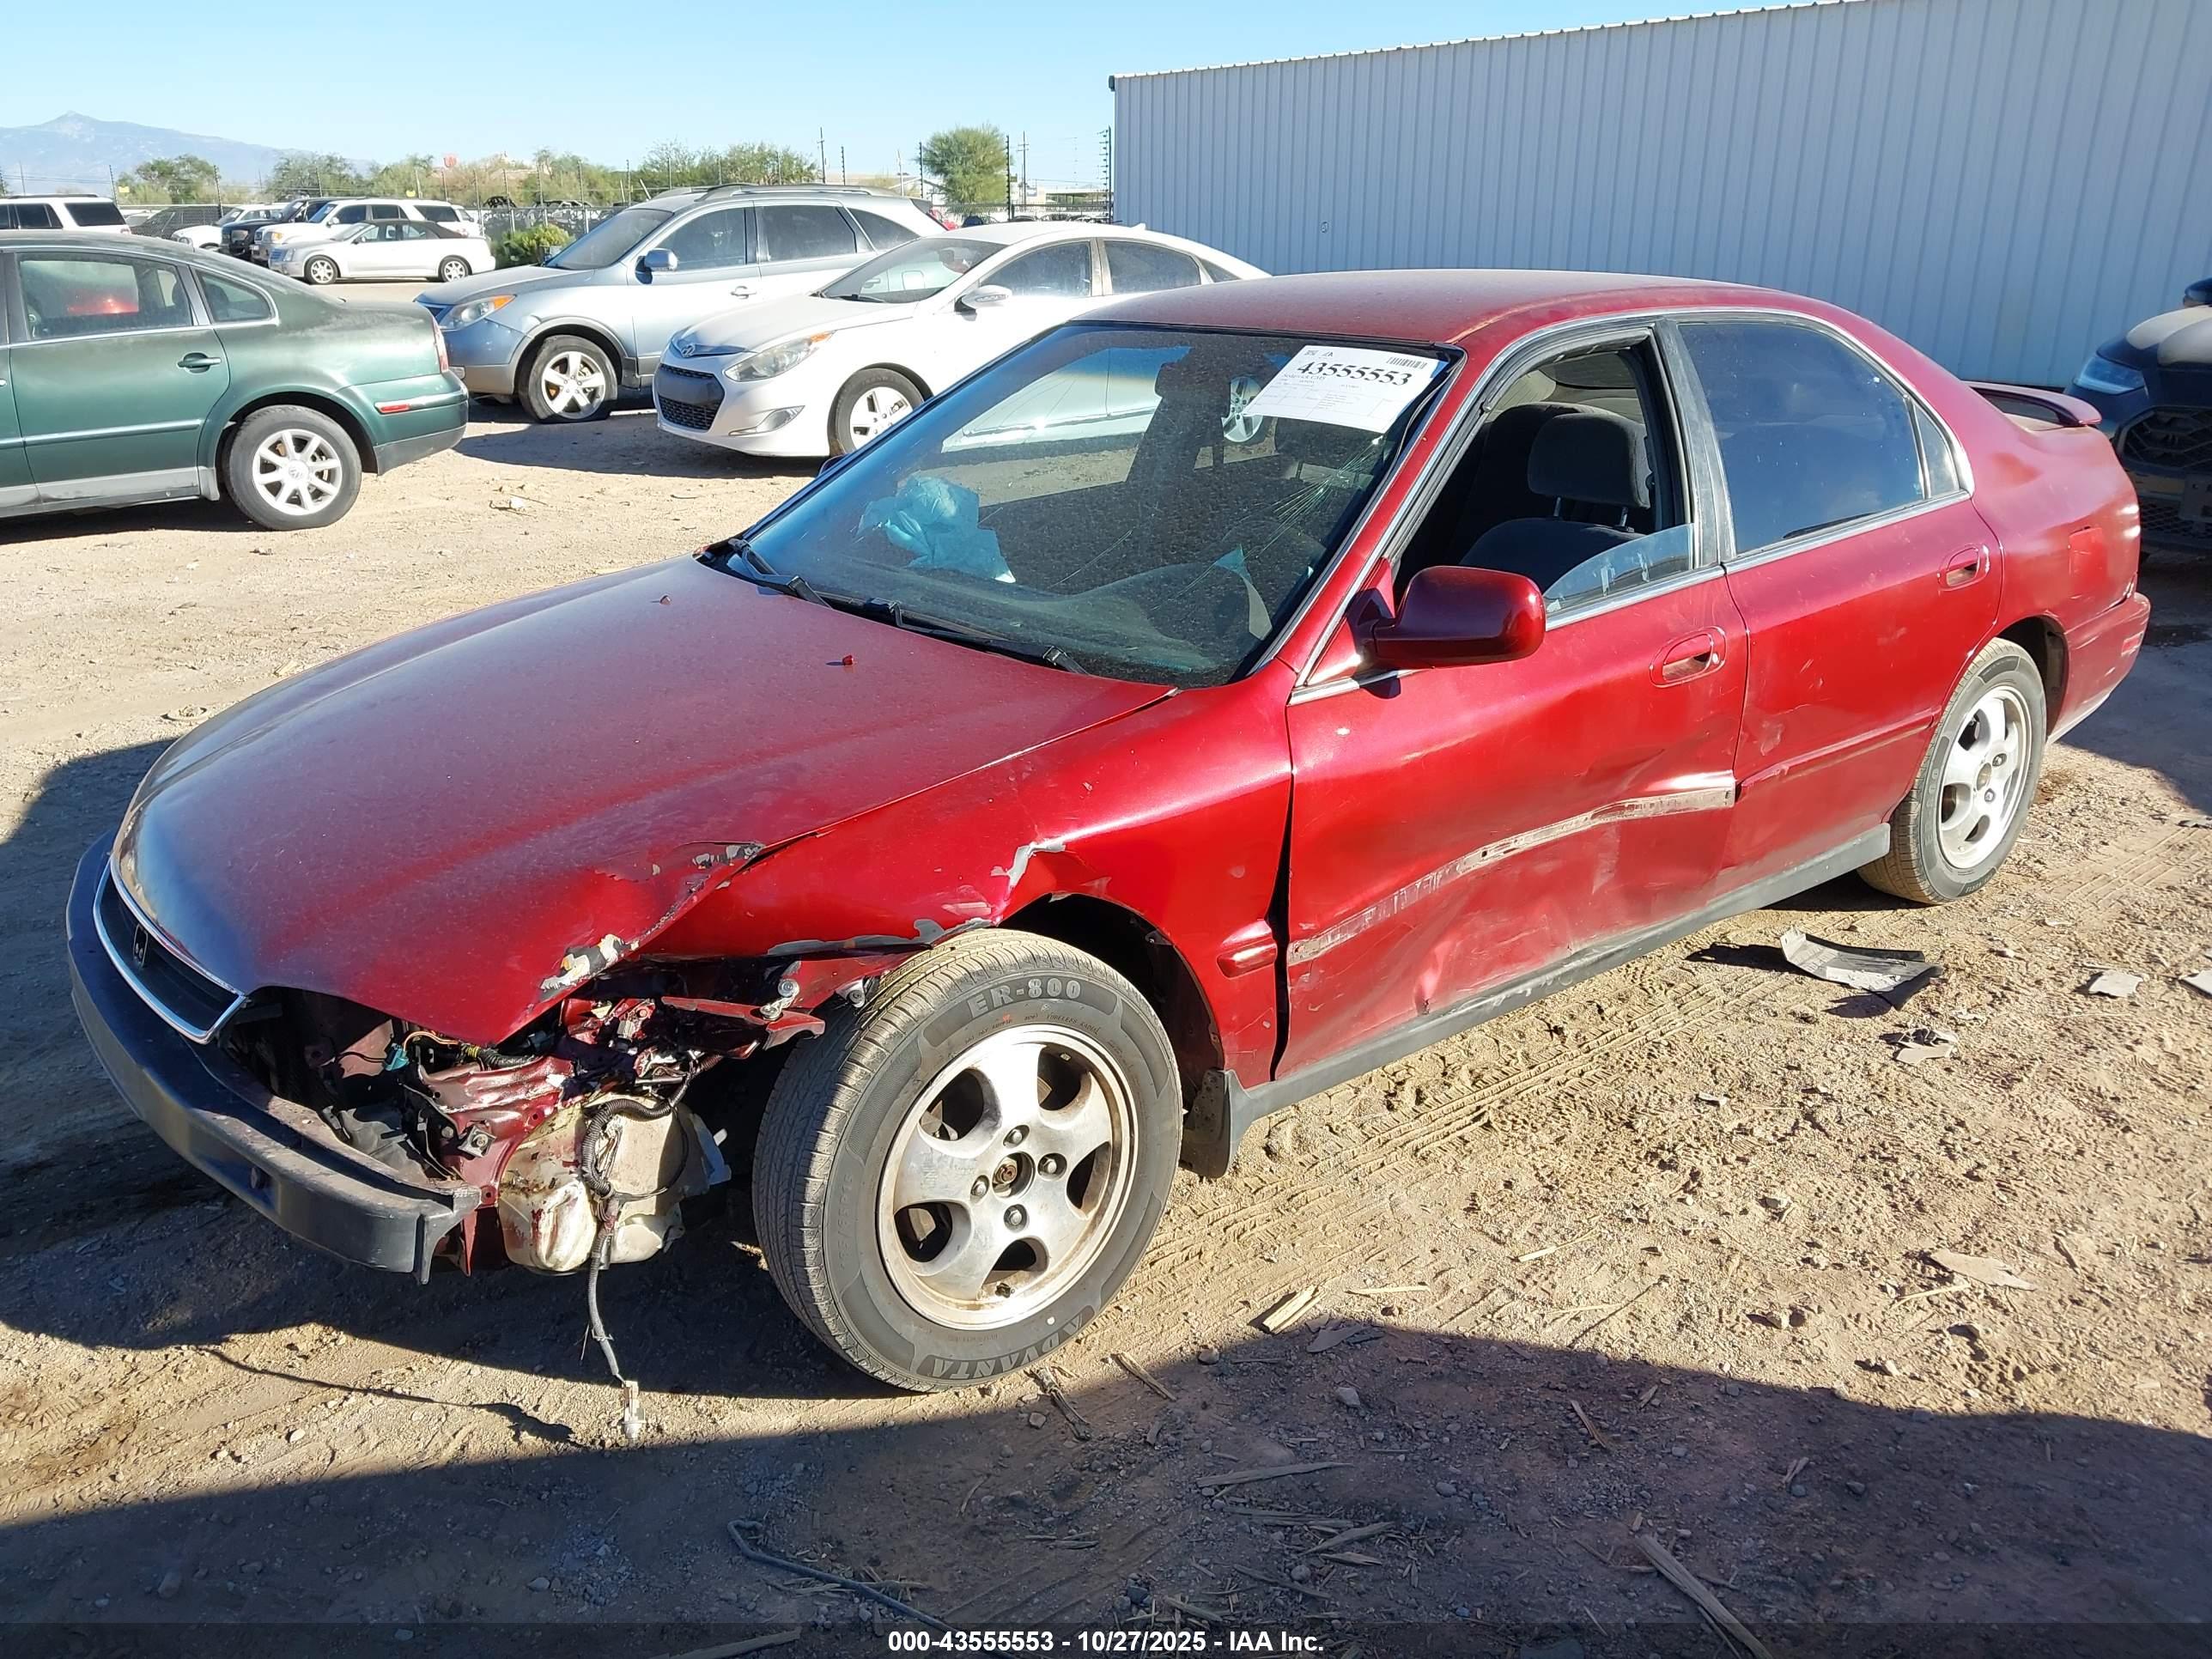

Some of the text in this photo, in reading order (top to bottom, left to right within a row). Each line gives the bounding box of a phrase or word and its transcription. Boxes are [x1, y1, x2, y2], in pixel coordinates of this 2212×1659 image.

[1297, 361, 1413, 386] 43555553
[967, 977, 1082, 1018] ER-800
[932, 1314, 1083, 1380] ADVANTA
